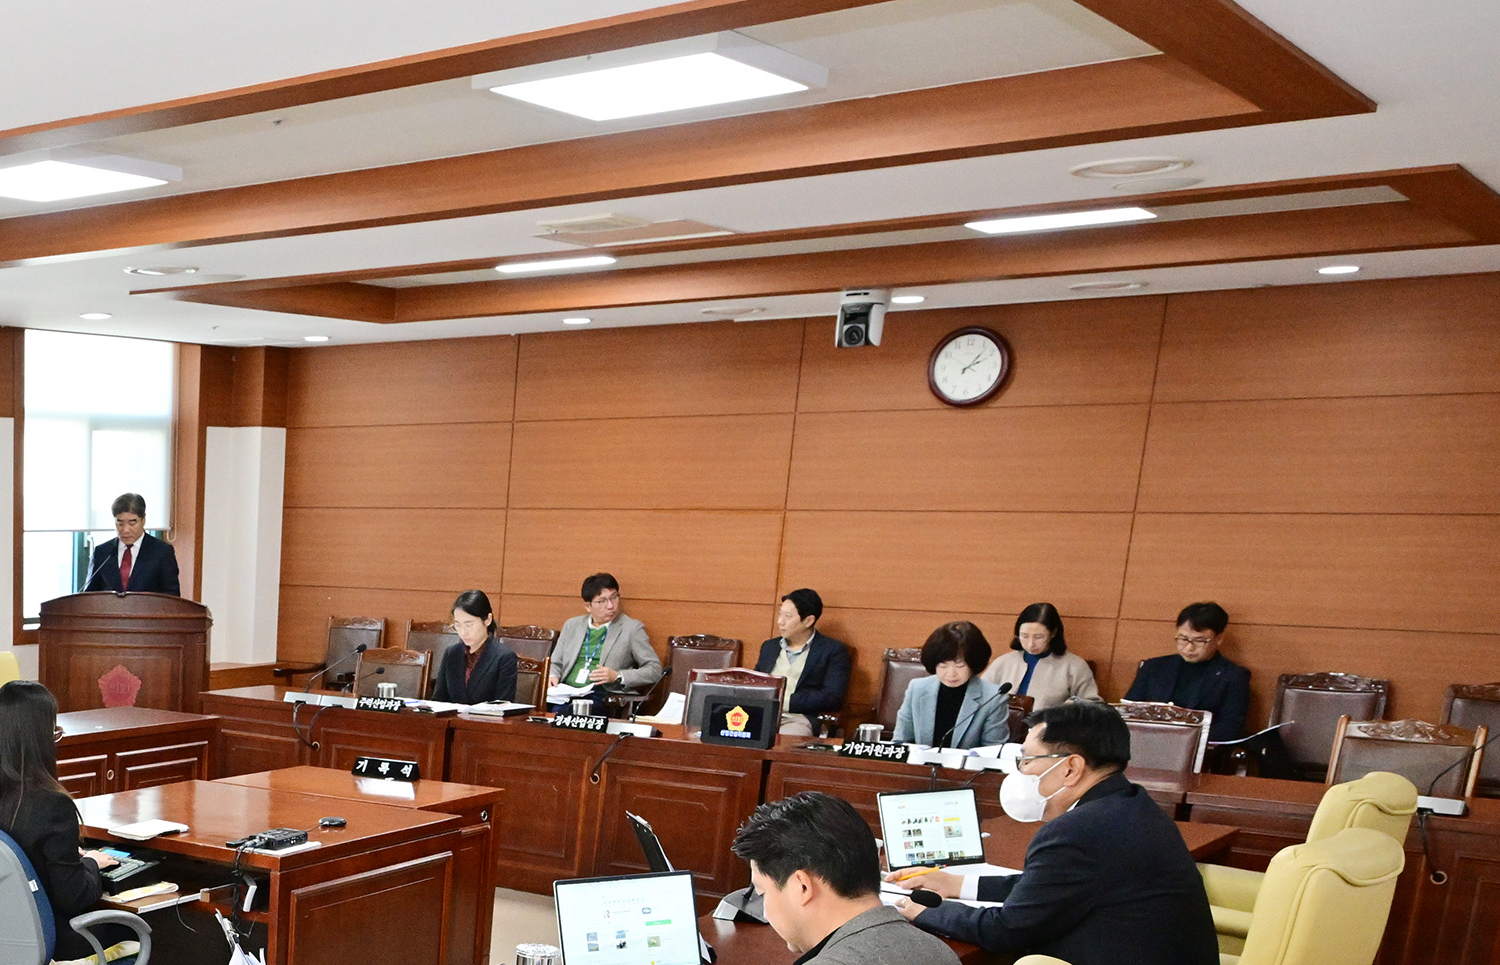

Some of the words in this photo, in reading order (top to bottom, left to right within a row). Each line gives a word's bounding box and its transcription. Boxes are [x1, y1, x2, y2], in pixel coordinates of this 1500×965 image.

[555, 714, 605, 731] 경제산업실장
[843, 741, 906, 760] 기업지원과장
[355, 759, 414, 777] 기록석
